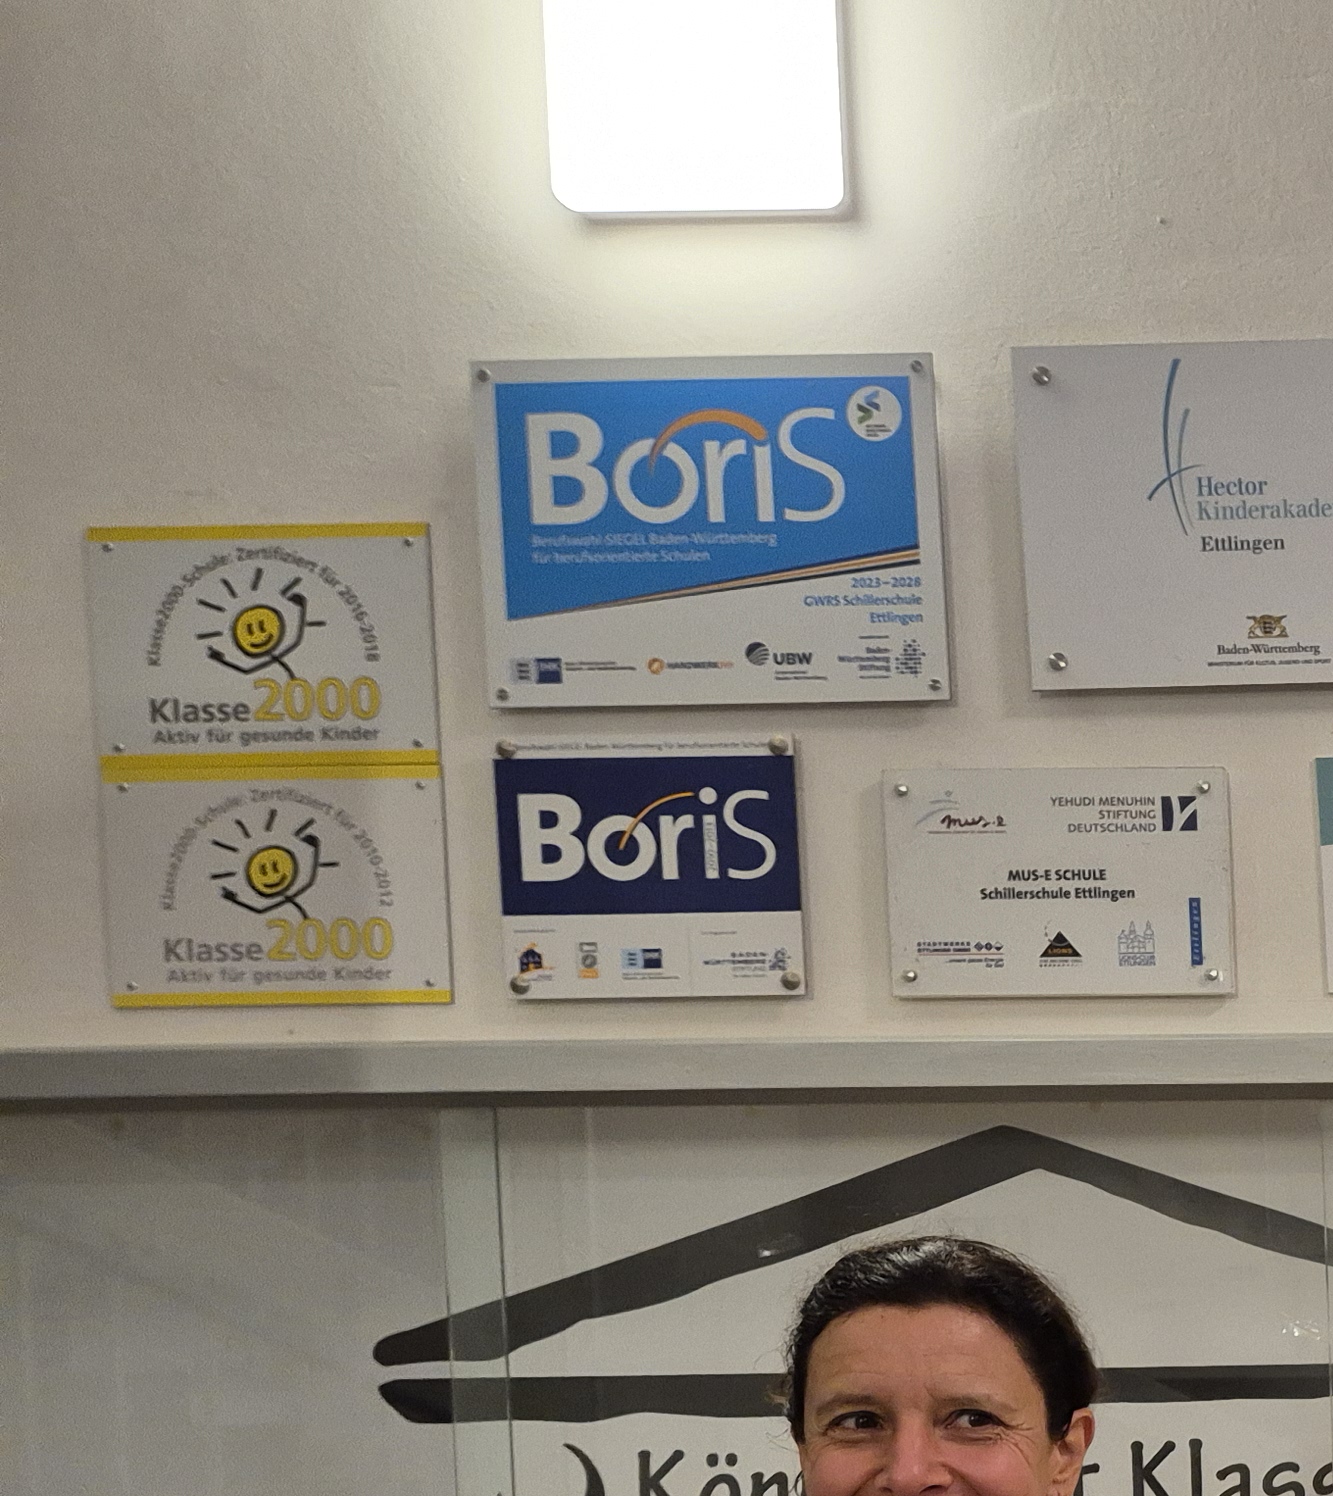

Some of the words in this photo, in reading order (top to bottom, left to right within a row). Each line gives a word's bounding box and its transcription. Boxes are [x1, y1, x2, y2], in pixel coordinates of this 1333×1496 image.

[525, 406, 846, 525] BoriS
[1196, 476, 1268, 497] Hector
[1200, 536, 1286, 554] Ettlingen
[869, 612, 923, 626] Ettlingen
[1217, 642, 1321, 656] Baden-Württemberg
[773, 652, 812, 665] UBW
[205, 728, 234, 744] für
[239, 728, 315, 747] gesunde
[320, 726, 381, 742] Kinder
[1051, 796, 1095, 807] YEHUDI
[1098, 796, 1156, 807] MENUHIN
[1098, 809, 1156, 820] STIFTUNG
[516, 787, 777, 882] BoriS
[1067, 822, 1157, 833] DEUTSCHLAND
[1007, 869, 1052, 882] MUS-E
[1054, 869, 1107, 881] SCHULE
[980, 887, 1071, 900] Schillerschule
[1074, 886, 1136, 902] Ettlingen
